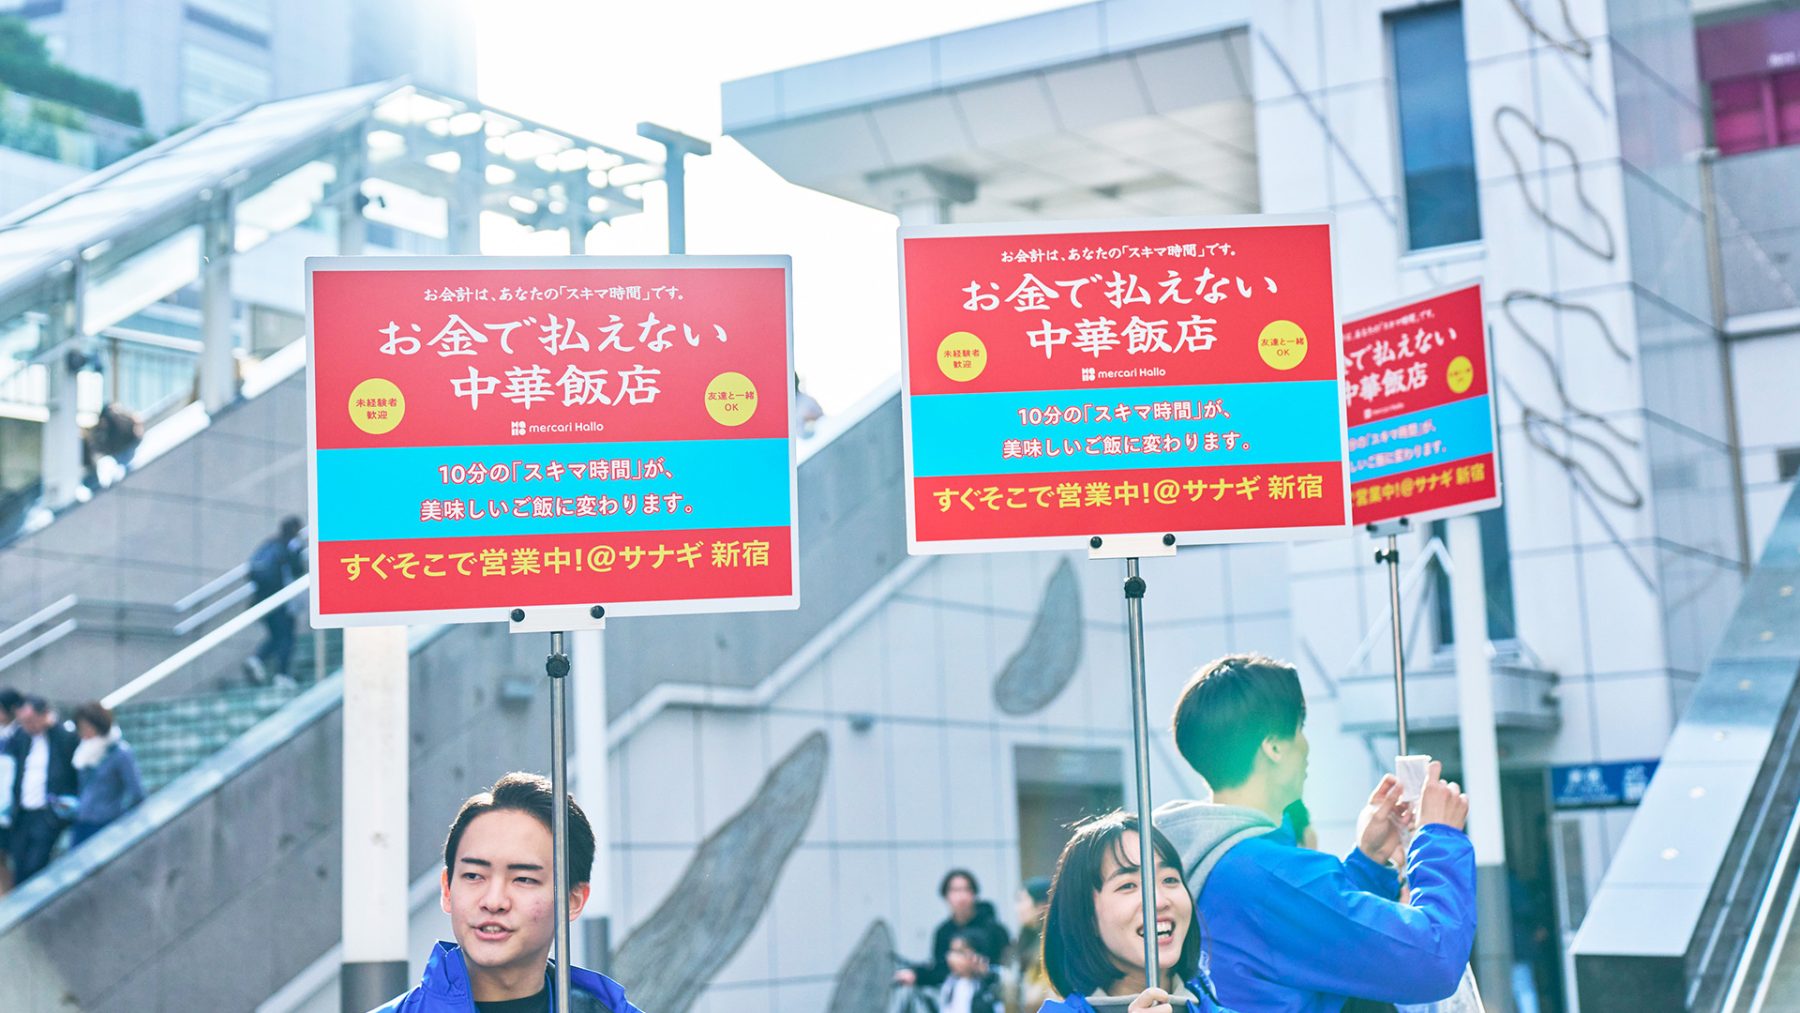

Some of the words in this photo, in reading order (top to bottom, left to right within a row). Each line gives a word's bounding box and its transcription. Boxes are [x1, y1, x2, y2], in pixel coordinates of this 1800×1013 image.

[962, 266, 1278, 313] お金で払えない
[379, 312, 727, 357] お金で払えない
[1026, 315, 1218, 359] 中華飯店
[1097, 368, 1137, 378] mercari
[1139, 367, 1166, 377] Hallo
[450, 364, 661, 410] 中華飯店
[707, 391, 755, 401] 友達と一緒
[355, 397, 398, 408] 未経験者
[366, 410, 388, 420] 歓迎
[724, 403, 739, 412] OK
[529, 422, 573, 433] mercari
[574, 421, 604, 432] Hallo
[1003, 431, 1249, 459] 美味しいご飯に変わります。
[1269, 474, 1322, 499] 新宿
[420, 493, 692, 522] 美味しいご飯に変わります。
[712, 540, 769, 567] 新宿
